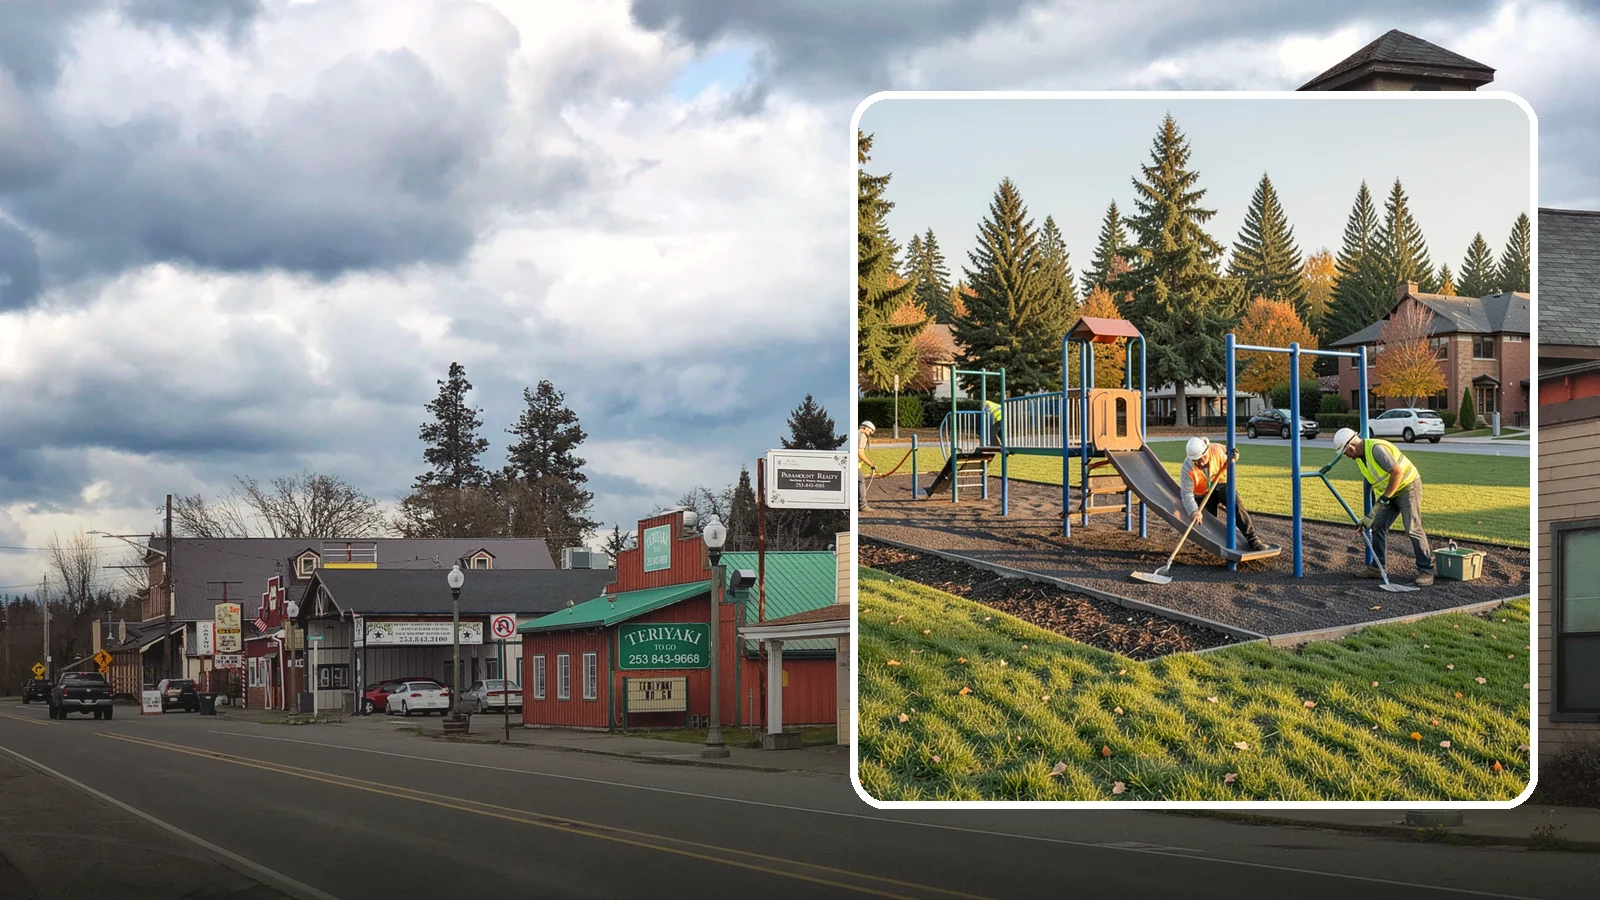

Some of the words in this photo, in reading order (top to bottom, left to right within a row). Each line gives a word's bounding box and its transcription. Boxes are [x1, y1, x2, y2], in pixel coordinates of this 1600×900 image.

[624, 627, 702, 646] TERIYAKI
[629, 654, 648, 665] 253
[651, 653, 700, 664] 843-9668
[639, 681, 672, 691] TERIYAKI
